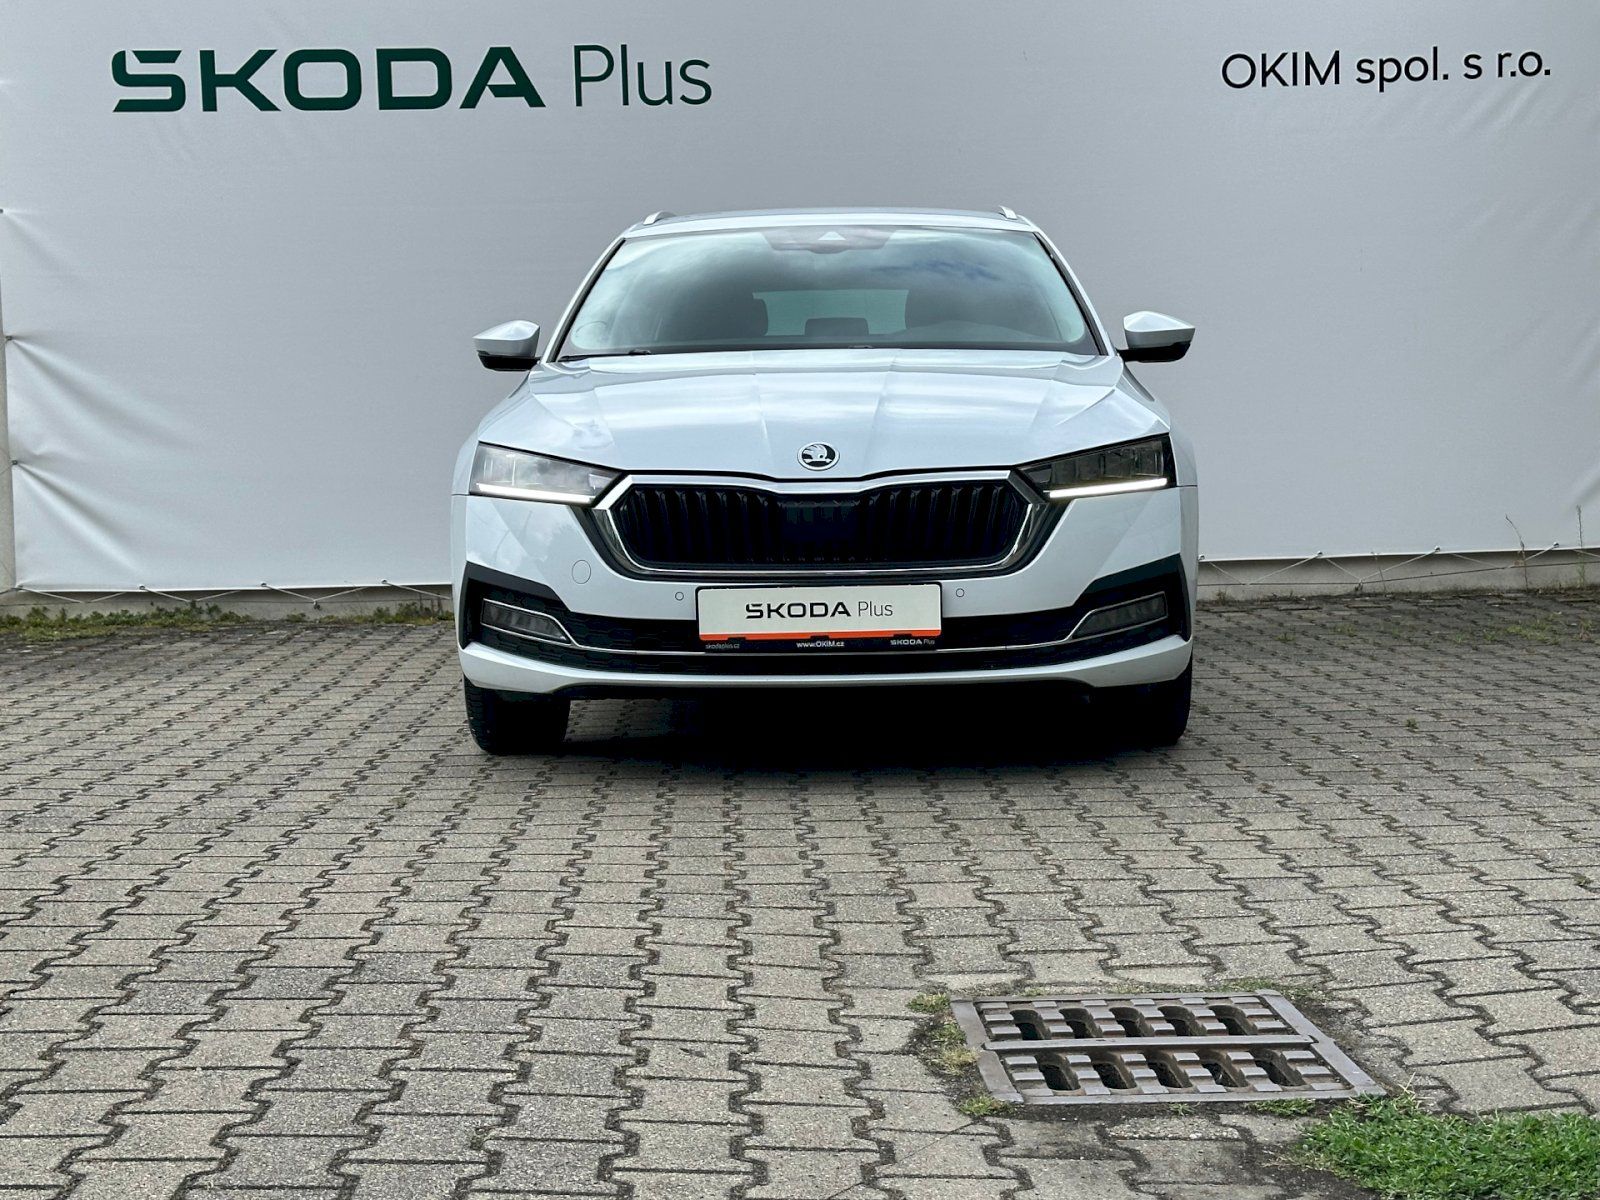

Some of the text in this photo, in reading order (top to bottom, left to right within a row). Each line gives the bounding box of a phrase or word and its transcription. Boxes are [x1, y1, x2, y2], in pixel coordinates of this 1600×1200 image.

[573, 43, 713, 108] Plus
[1221, 45, 1551, 93] OKIM spol. s r.o.
[858, 600, 893, 617] Plus
[796, 640, 845, 648] www.OKIM.cz
